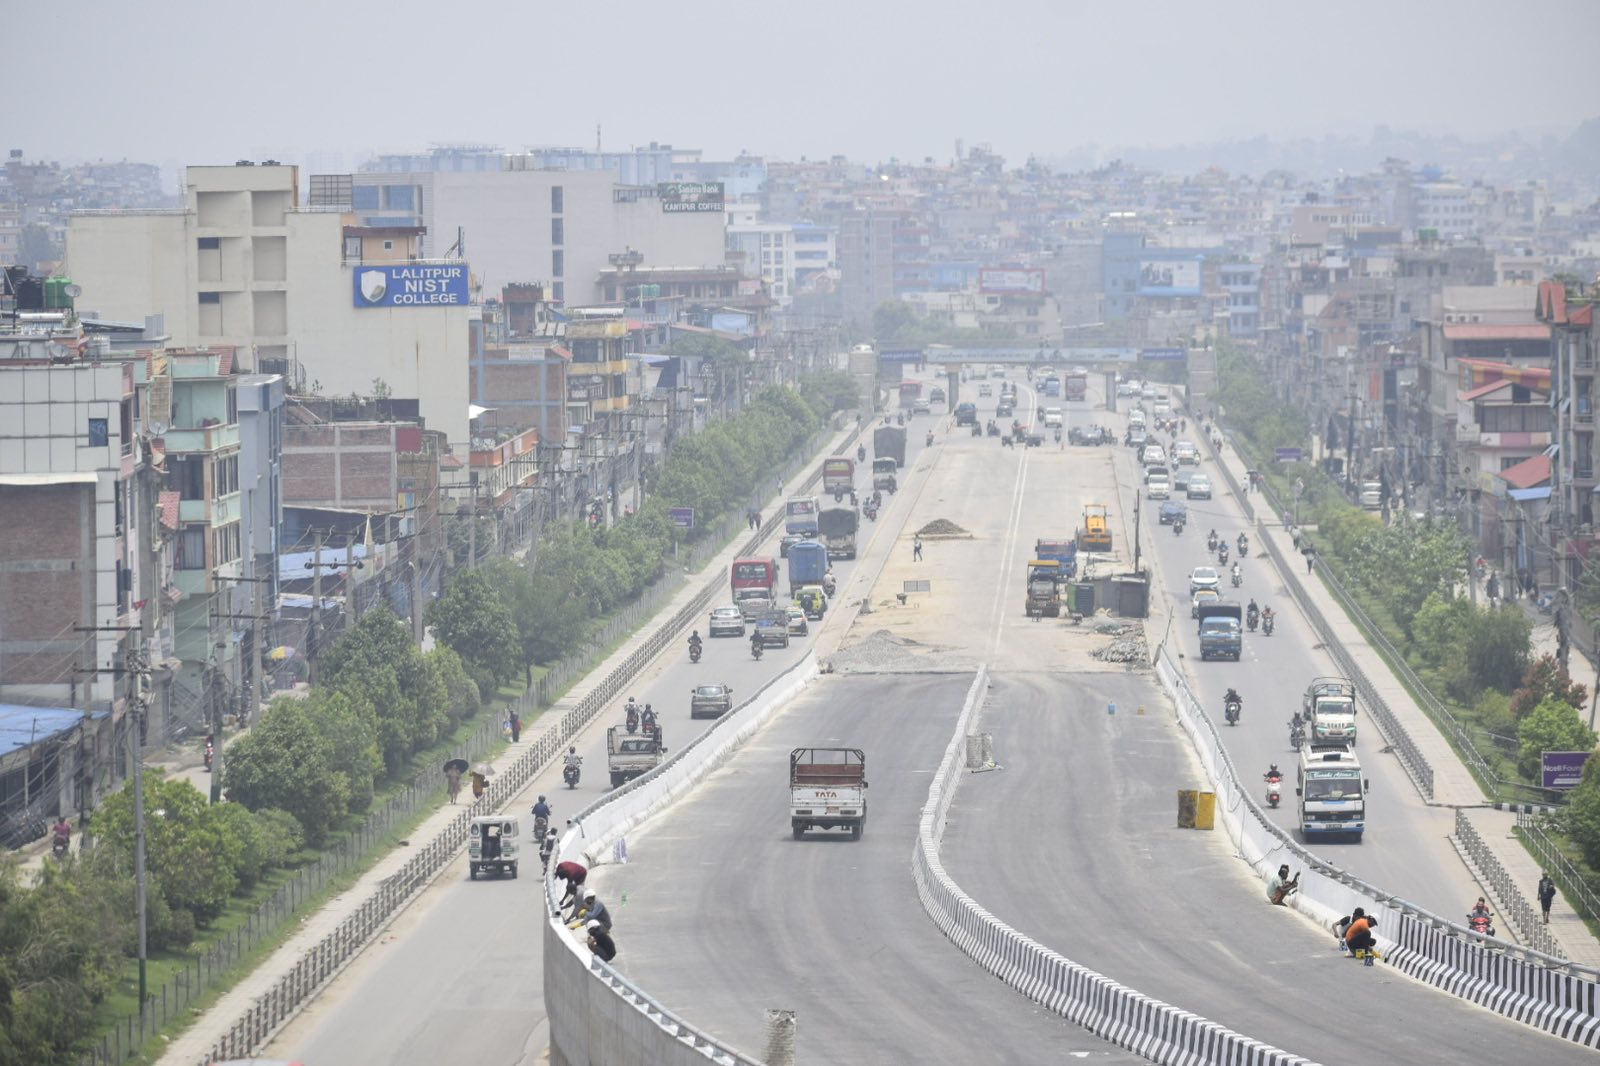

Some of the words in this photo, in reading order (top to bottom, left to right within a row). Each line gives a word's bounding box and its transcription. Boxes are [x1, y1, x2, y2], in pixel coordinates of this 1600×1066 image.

[703, 183, 720, 194] Bank
[664, 203, 697, 211] KANTIPUR
[698, 202, 723, 211] COFFEE
[392, 268, 461, 279] LALITPUR
[405, 279, 450, 293] NIST
[393, 293, 458, 304] COLLEGE
